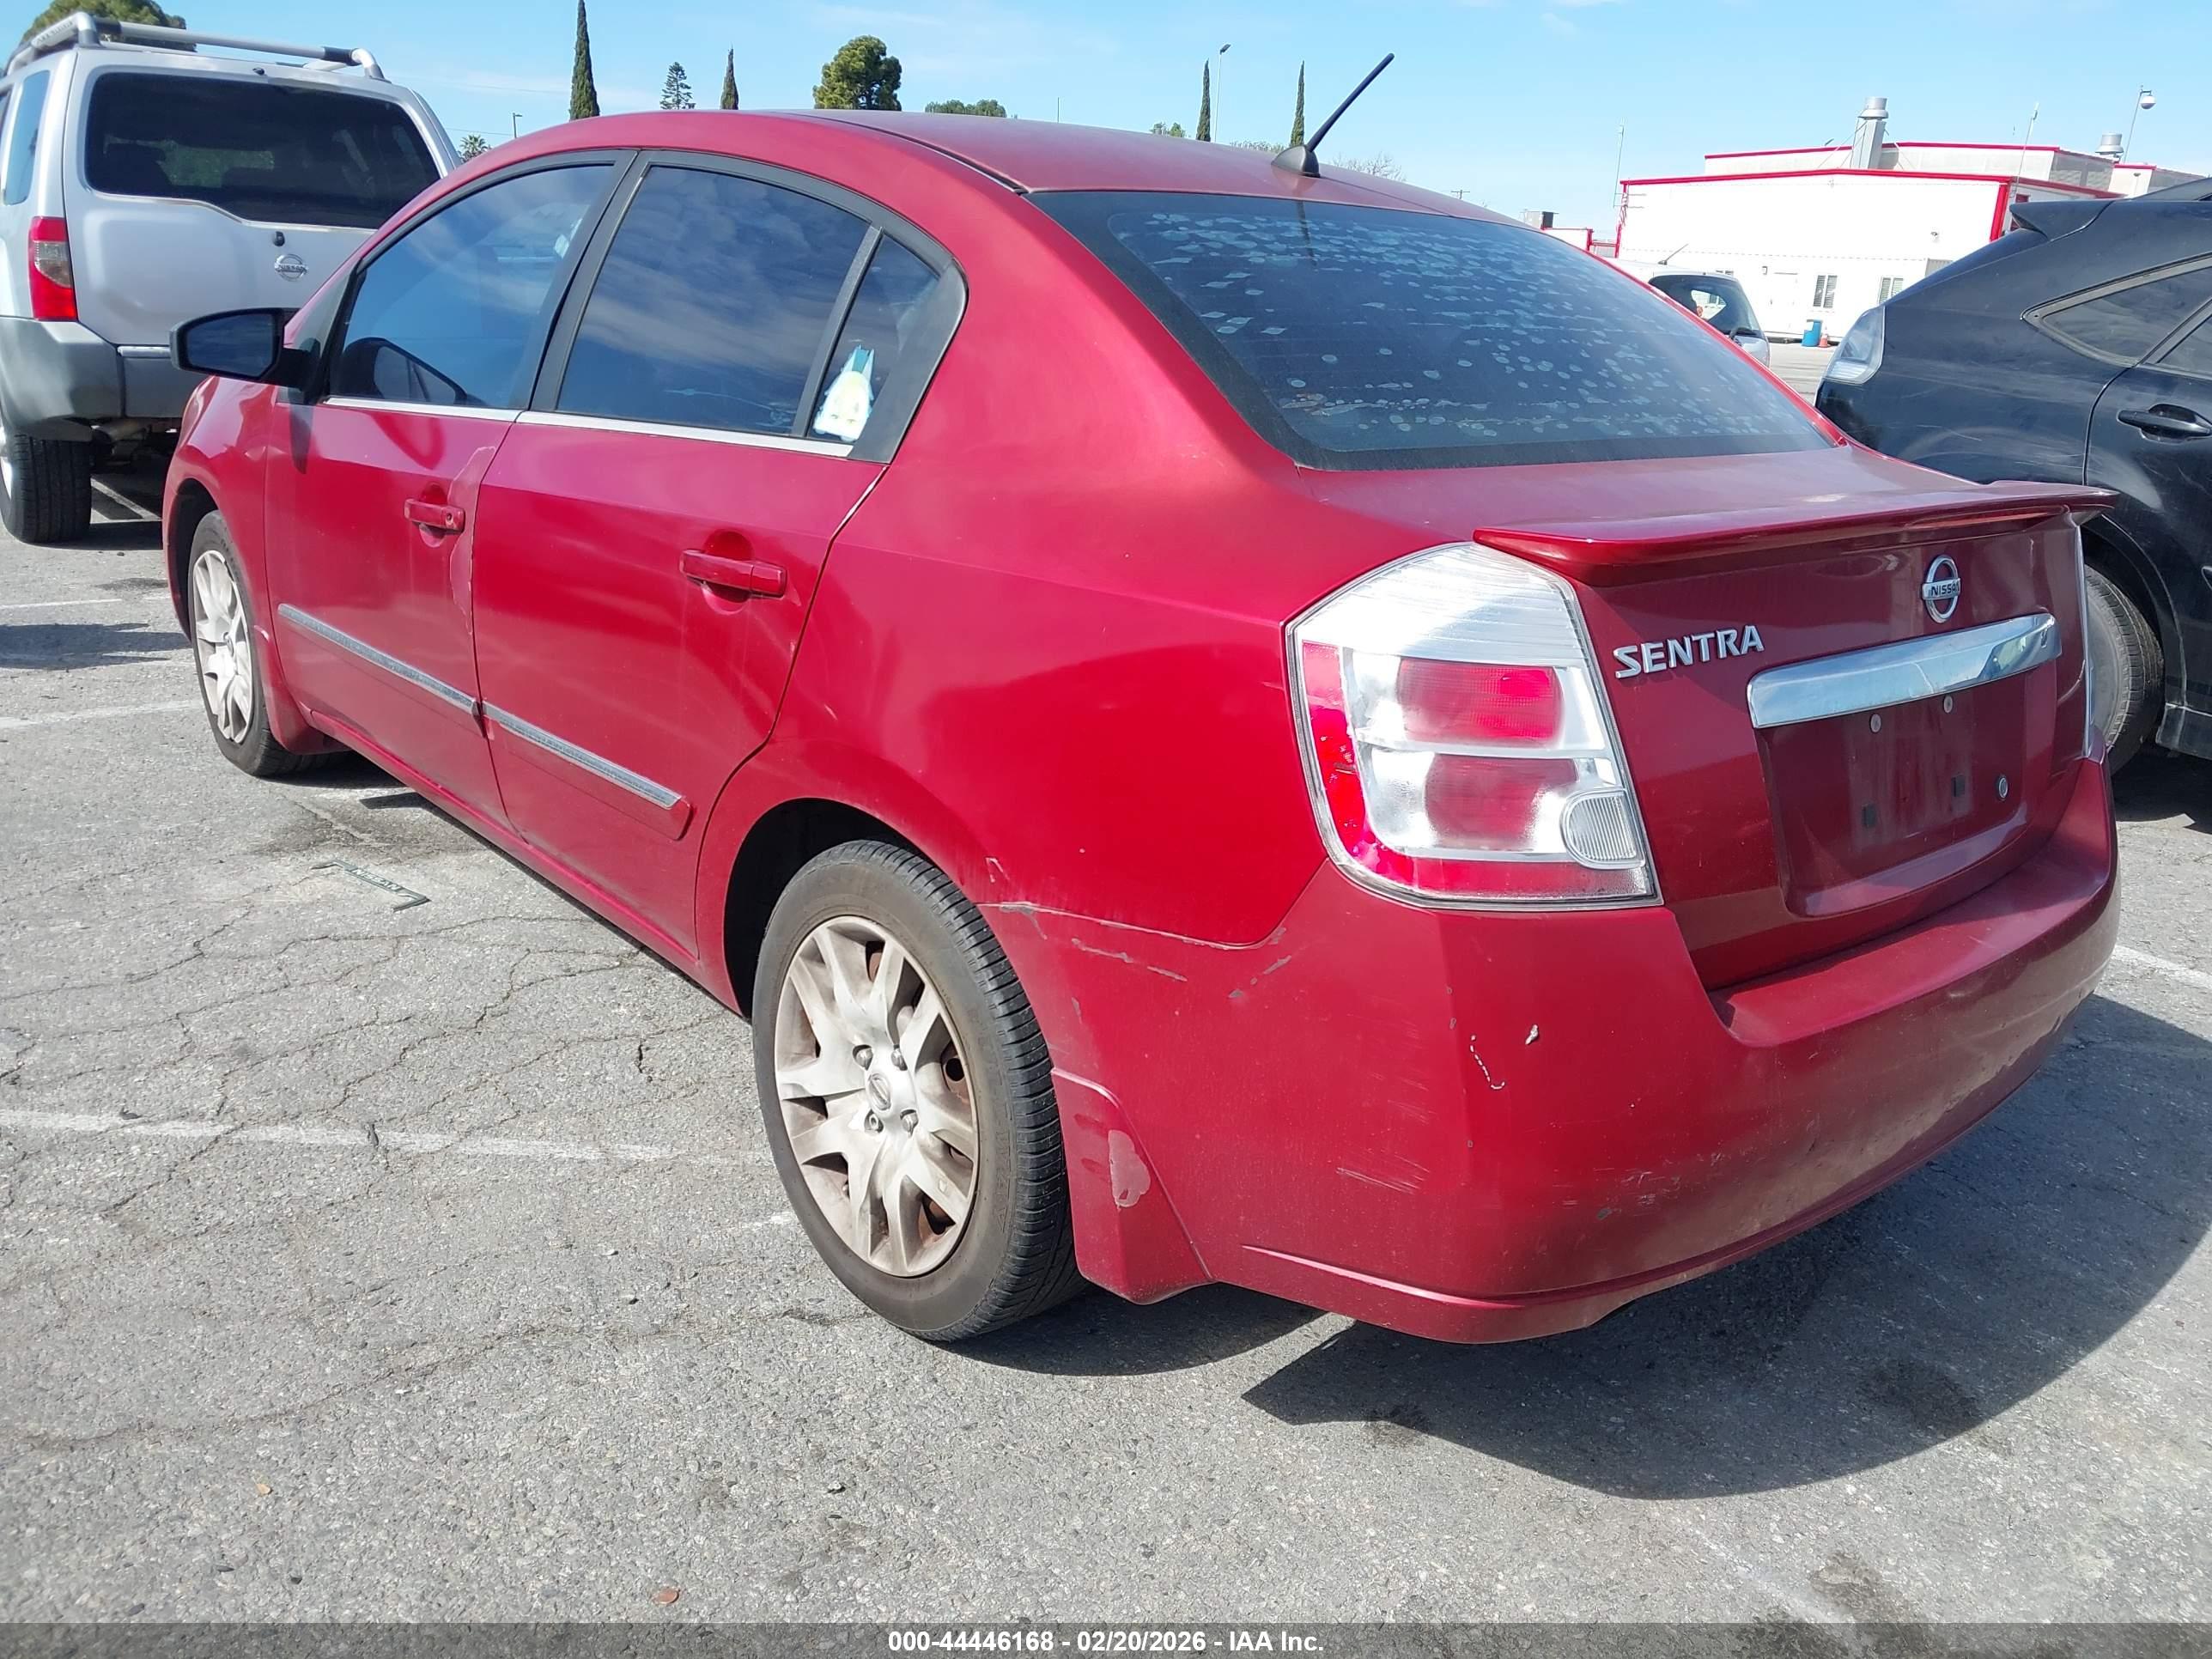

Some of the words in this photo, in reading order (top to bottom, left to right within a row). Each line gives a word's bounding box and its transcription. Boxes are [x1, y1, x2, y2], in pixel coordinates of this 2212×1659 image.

[1930, 581, 1960, 597] NISSAN
[1613, 624, 1765, 678] SENTRA
[351, 869, 401, 891] NISSAN
